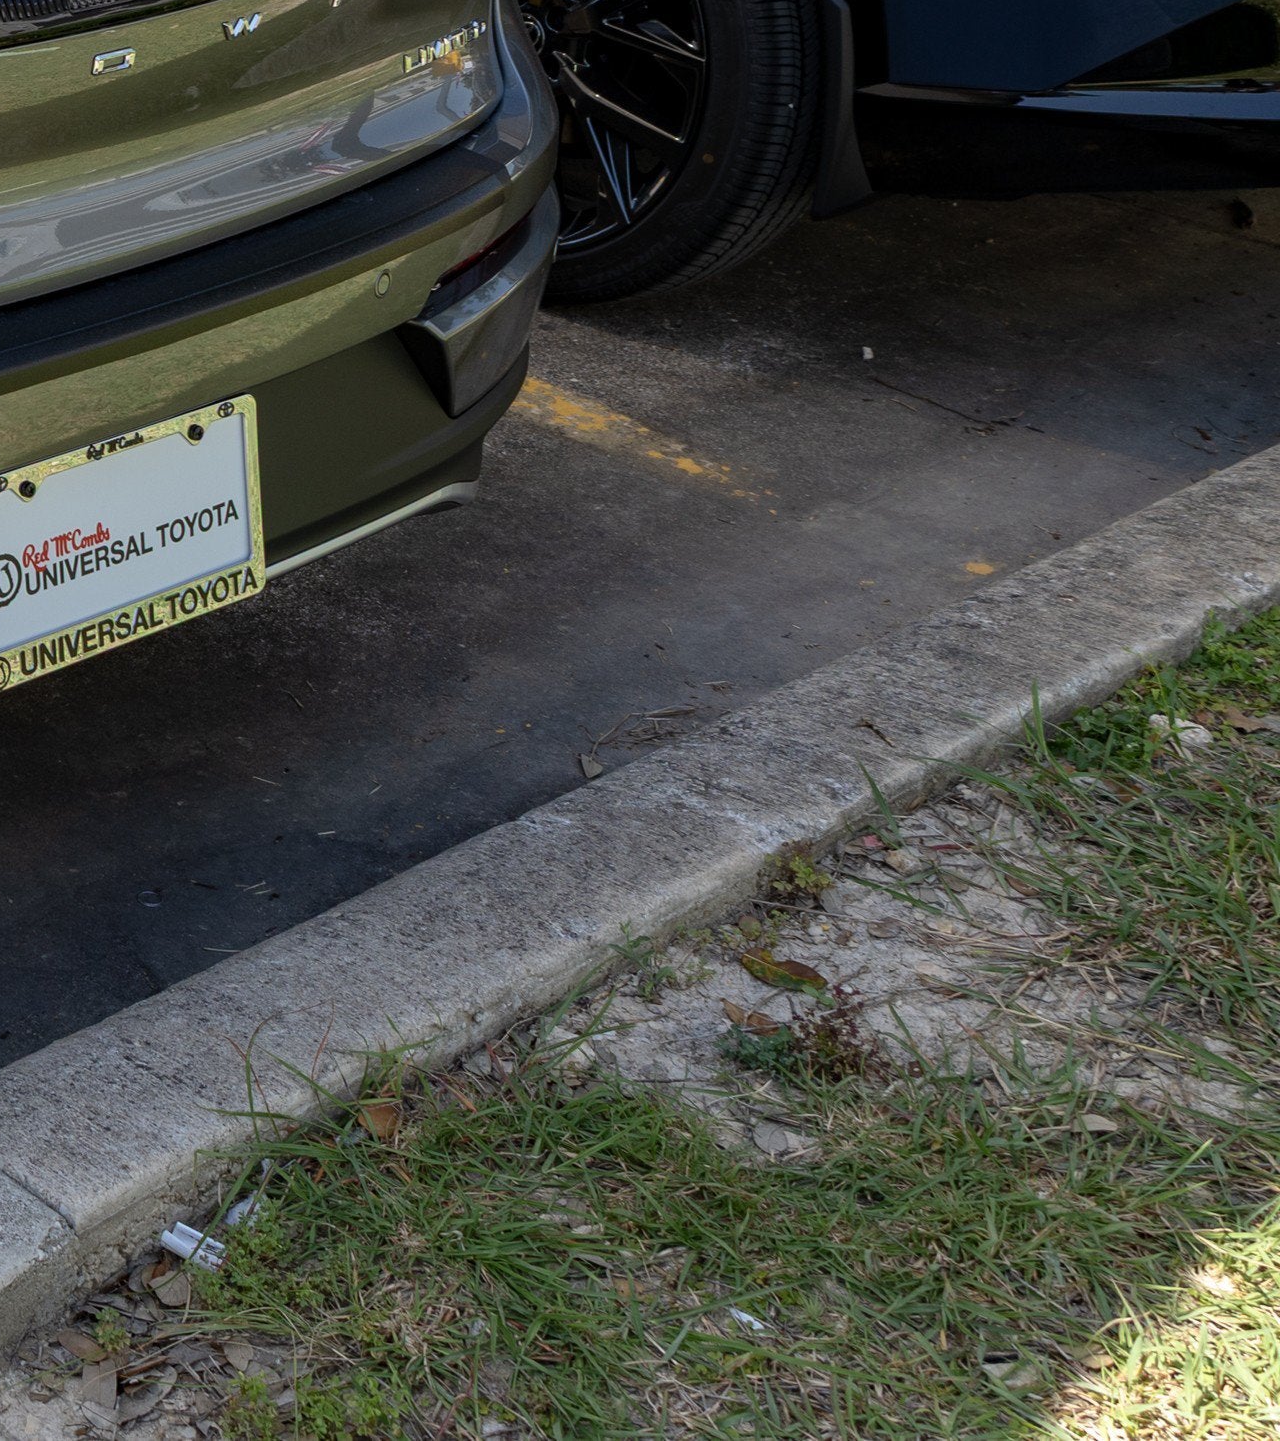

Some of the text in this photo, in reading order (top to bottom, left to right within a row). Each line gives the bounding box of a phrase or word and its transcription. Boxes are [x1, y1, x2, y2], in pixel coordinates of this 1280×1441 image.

[22, 522, 111, 573] Red McCombs
[25, 531, 154, 596] UNIVERSAL
[156, 499, 240, 548] TOYOTA
[18, 605, 164, 676] UNIVERSAL
[164, 566, 259, 620] TOYOTA
